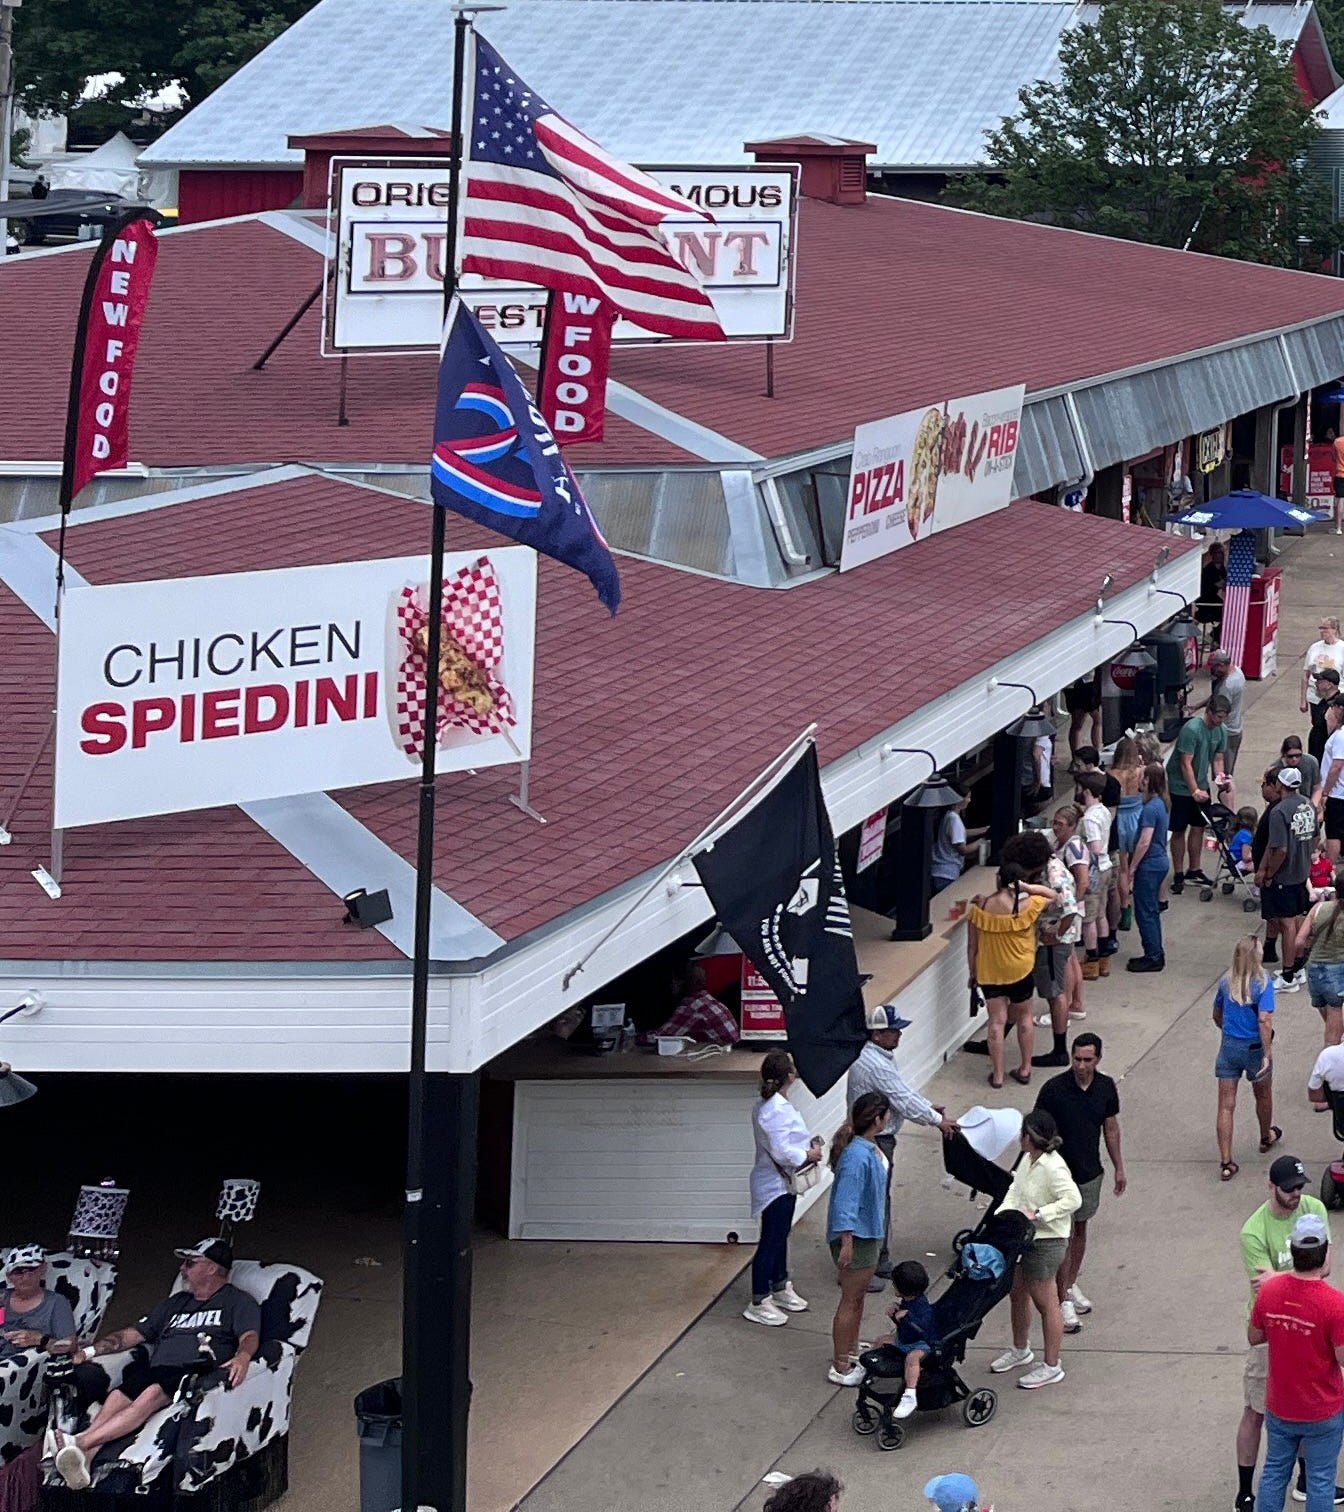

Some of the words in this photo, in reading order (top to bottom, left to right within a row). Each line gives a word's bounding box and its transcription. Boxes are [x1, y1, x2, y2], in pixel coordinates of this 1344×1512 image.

[352, 182, 450, 207] ORIG
[670, 184, 782, 208] MOUS
[102, 238, 138, 328] NEW
[91, 338, 124, 460] FOOD
[553, 325, 593, 433] FOOD
[986, 420, 1018, 460] RIB
[849, 458, 905, 521] PIZZA
[103, 620, 361, 688] CHICKEN
[79, 671, 379, 757] SPIEDINI
